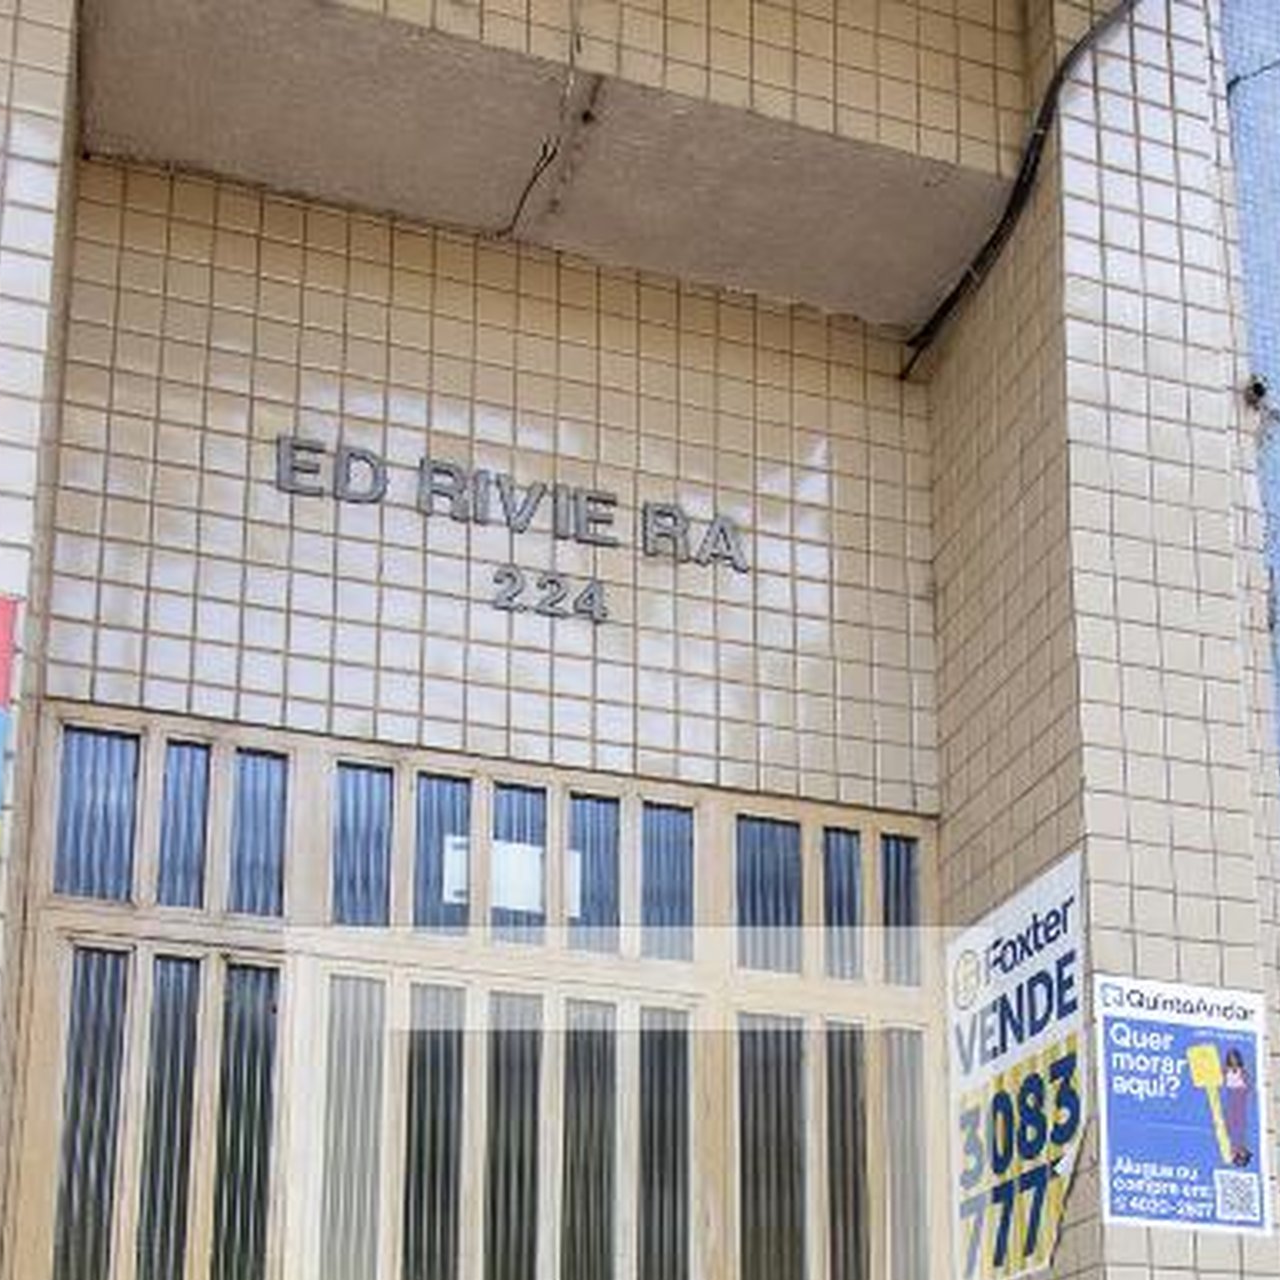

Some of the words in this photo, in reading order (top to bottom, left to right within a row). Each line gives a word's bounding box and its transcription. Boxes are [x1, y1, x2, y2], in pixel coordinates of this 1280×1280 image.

[276, 434, 388, 504] ED
[492, 563, 609, 624] 224
[985, 895, 1075, 986] Foxter
[954, 949, 1079, 1076] VENDE
[1109, 1022, 1175, 1051] Quer
[1126, 989, 1256, 1021] QuintoAndar
[1111, 1052, 1189, 1075] morar
[1112, 1073, 1181, 1102] aqui?
[959, 1052, 1081, 1189] 3083
[960, 1156, 1062, 1280] 777
